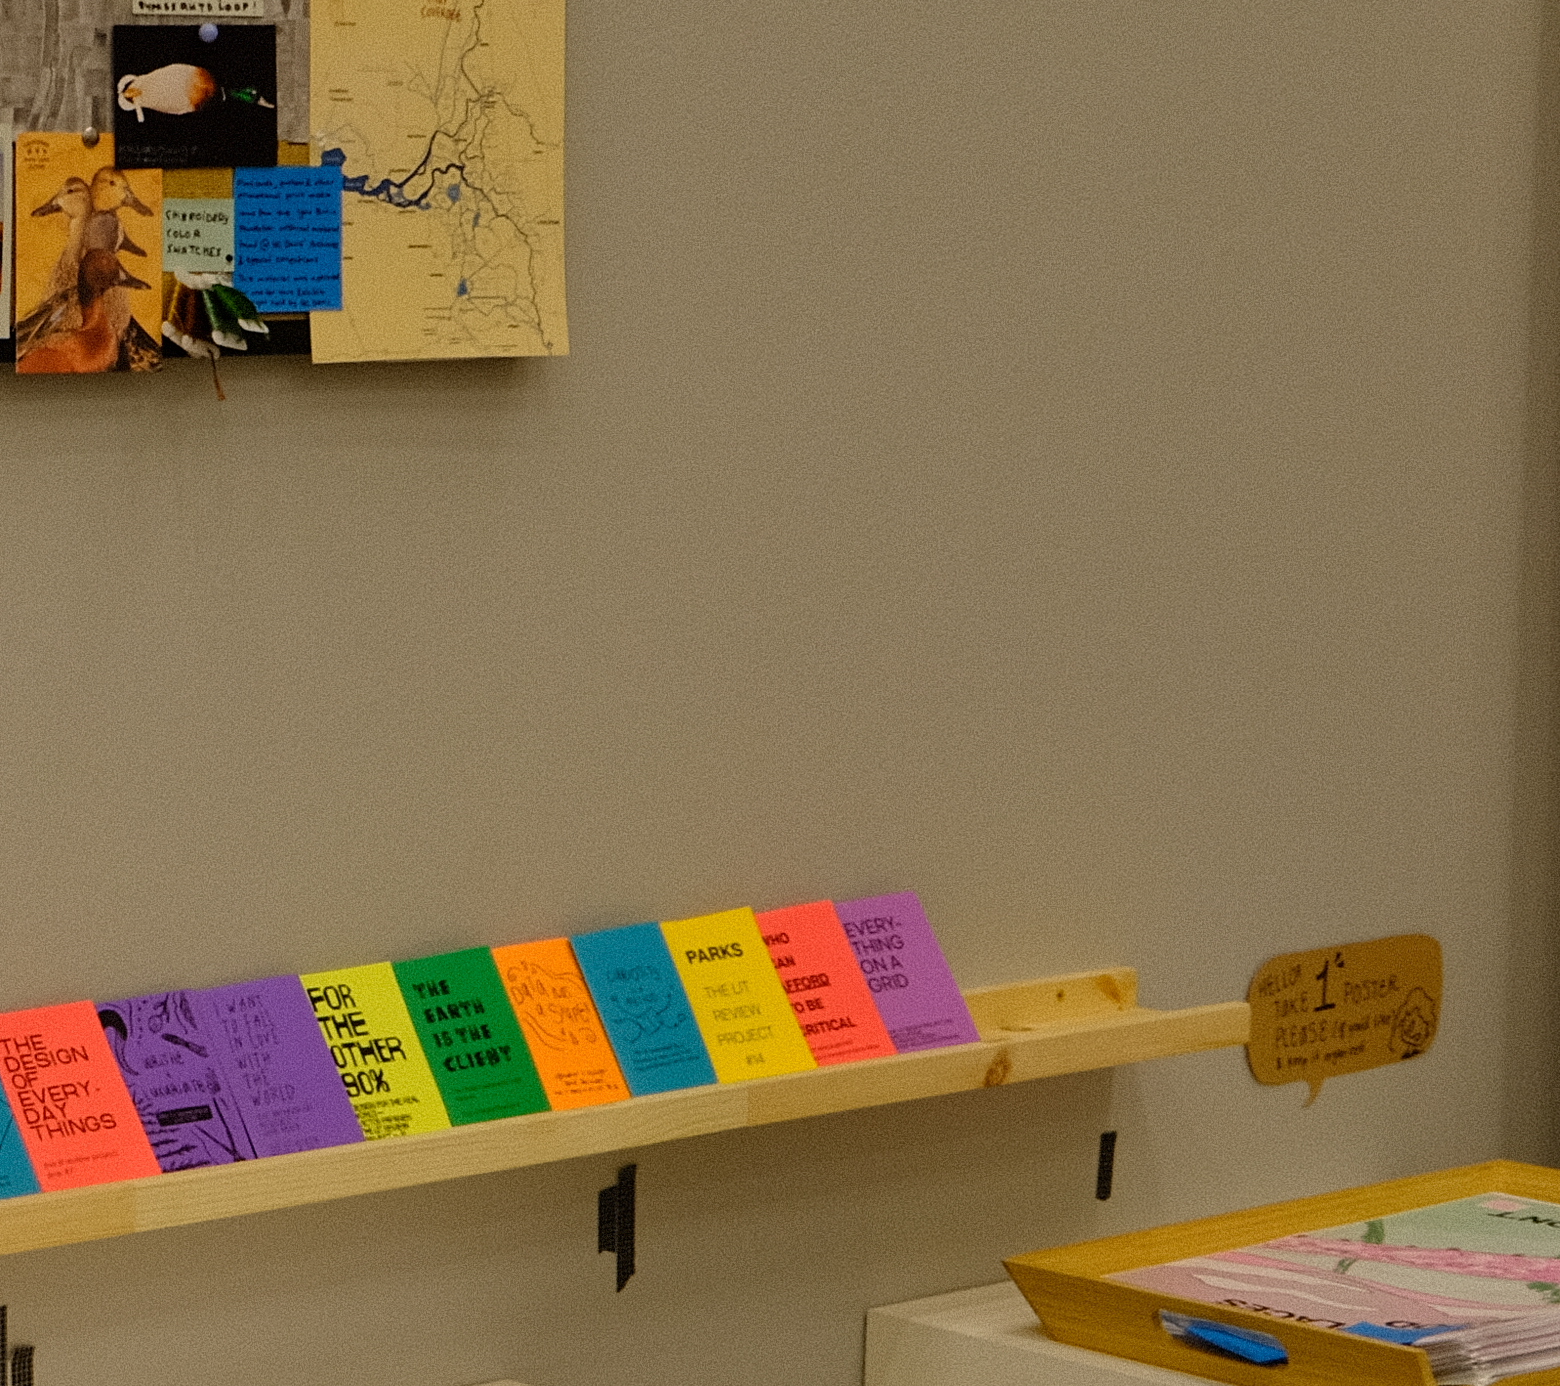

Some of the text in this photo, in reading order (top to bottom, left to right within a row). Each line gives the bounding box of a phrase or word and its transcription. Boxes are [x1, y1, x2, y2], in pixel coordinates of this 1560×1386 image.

[685, 943, 743, 964] PARKS
[852, 935, 904, 954] THING
[773, 955, 796, 969] AN
[861, 955, 903, 974] ON A
[413, 980, 450, 998] THE
[783, 973, 831, 994] FFORD
[868, 974, 909, 993] GRID
[307, 984, 356, 1012] FOR
[806, 998, 823, 1011] BE
[425, 998, 485, 1023] EARTH
[318, 1013, 369, 1041] THE
[434, 1024, 491, 1048] IS THE
[804, 1017, 857, 1036] RITICAL
[4, 1046, 88, 1073] DESIGN
[331, 1038, 406, 1069] OTHER
[443, 1046, 511, 1072] CLIENT
[12, 1072, 37, 1090] OF
[341, 1069, 390, 1097] 90%
[24, 1102, 68, 1125] DAY
[31, 1114, 116, 1141] THINGS
